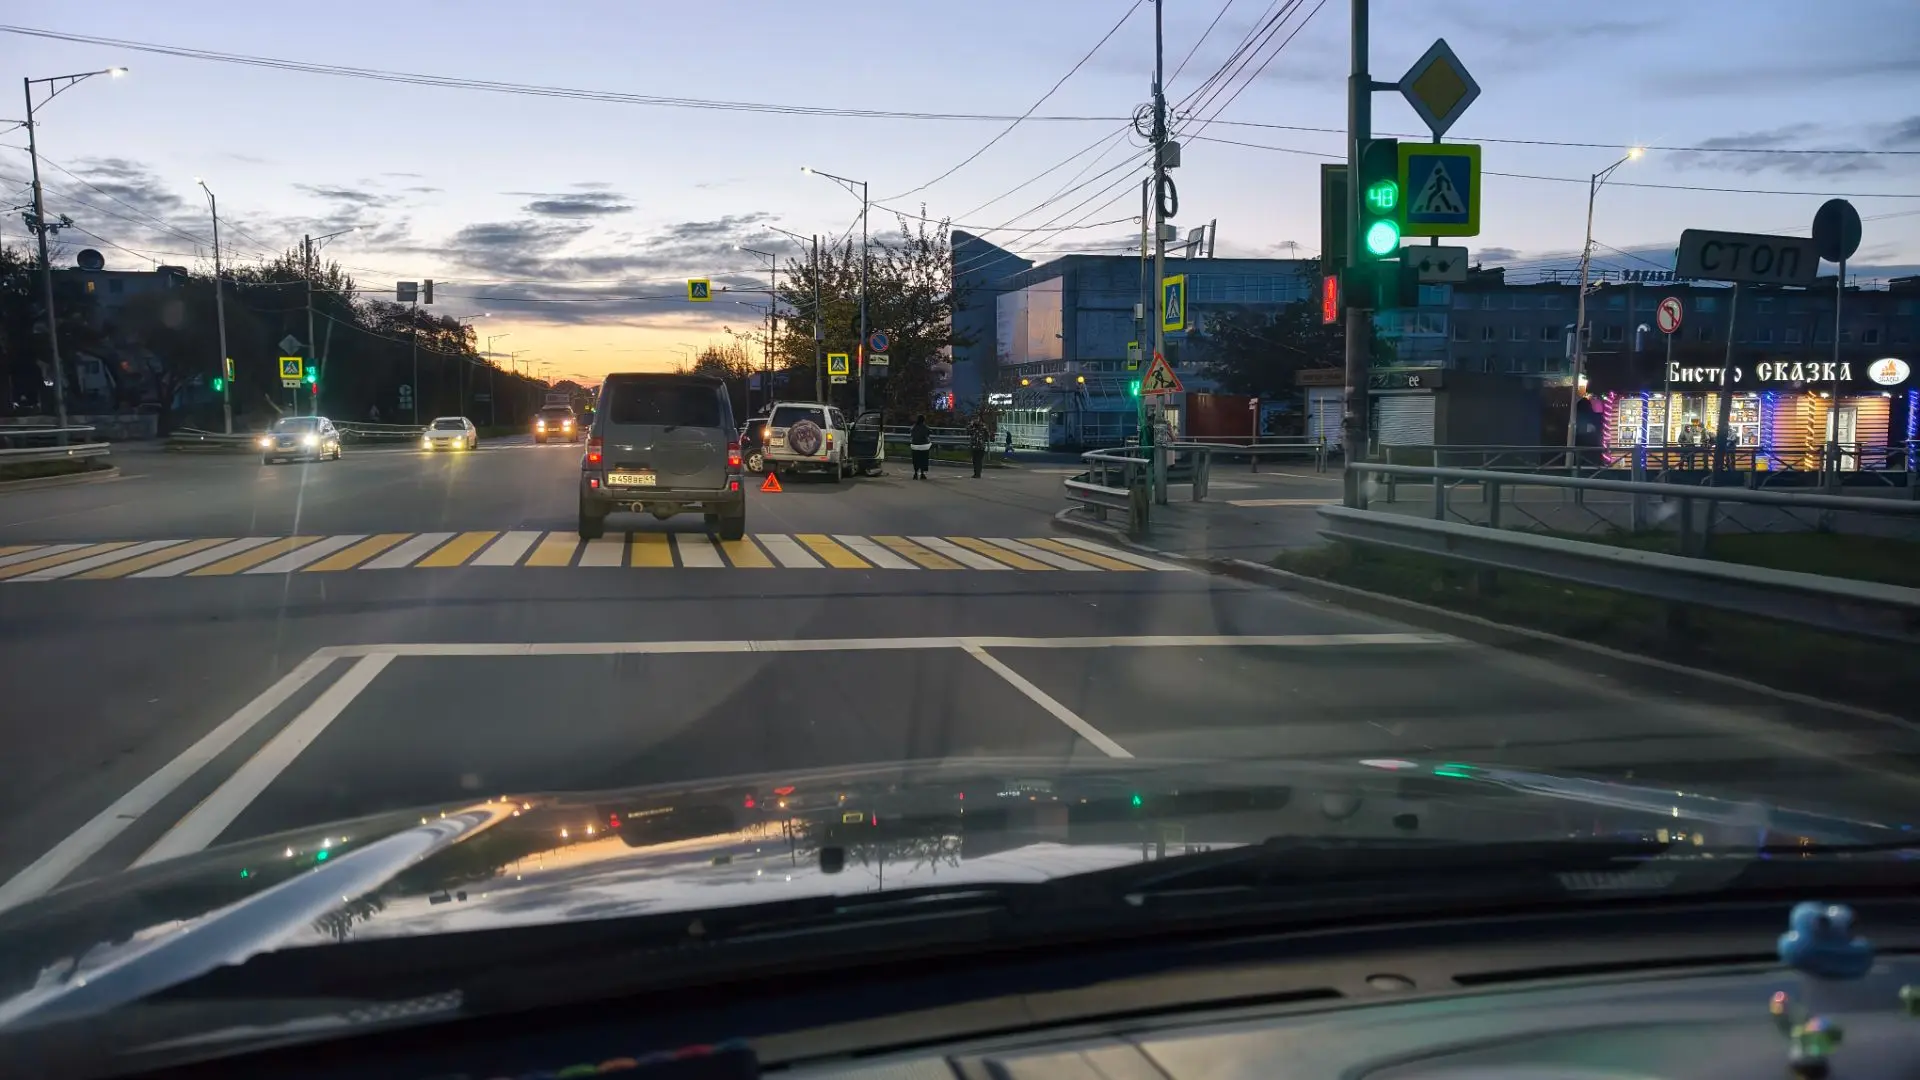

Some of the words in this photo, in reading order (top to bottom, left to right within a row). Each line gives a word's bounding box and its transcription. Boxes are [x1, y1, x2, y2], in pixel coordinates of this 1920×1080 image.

[1369, 185, 1393, 207] 48
[1701, 240, 1800, 277] СТОП
[1756, 361, 1853, 383] СКАЗКА
